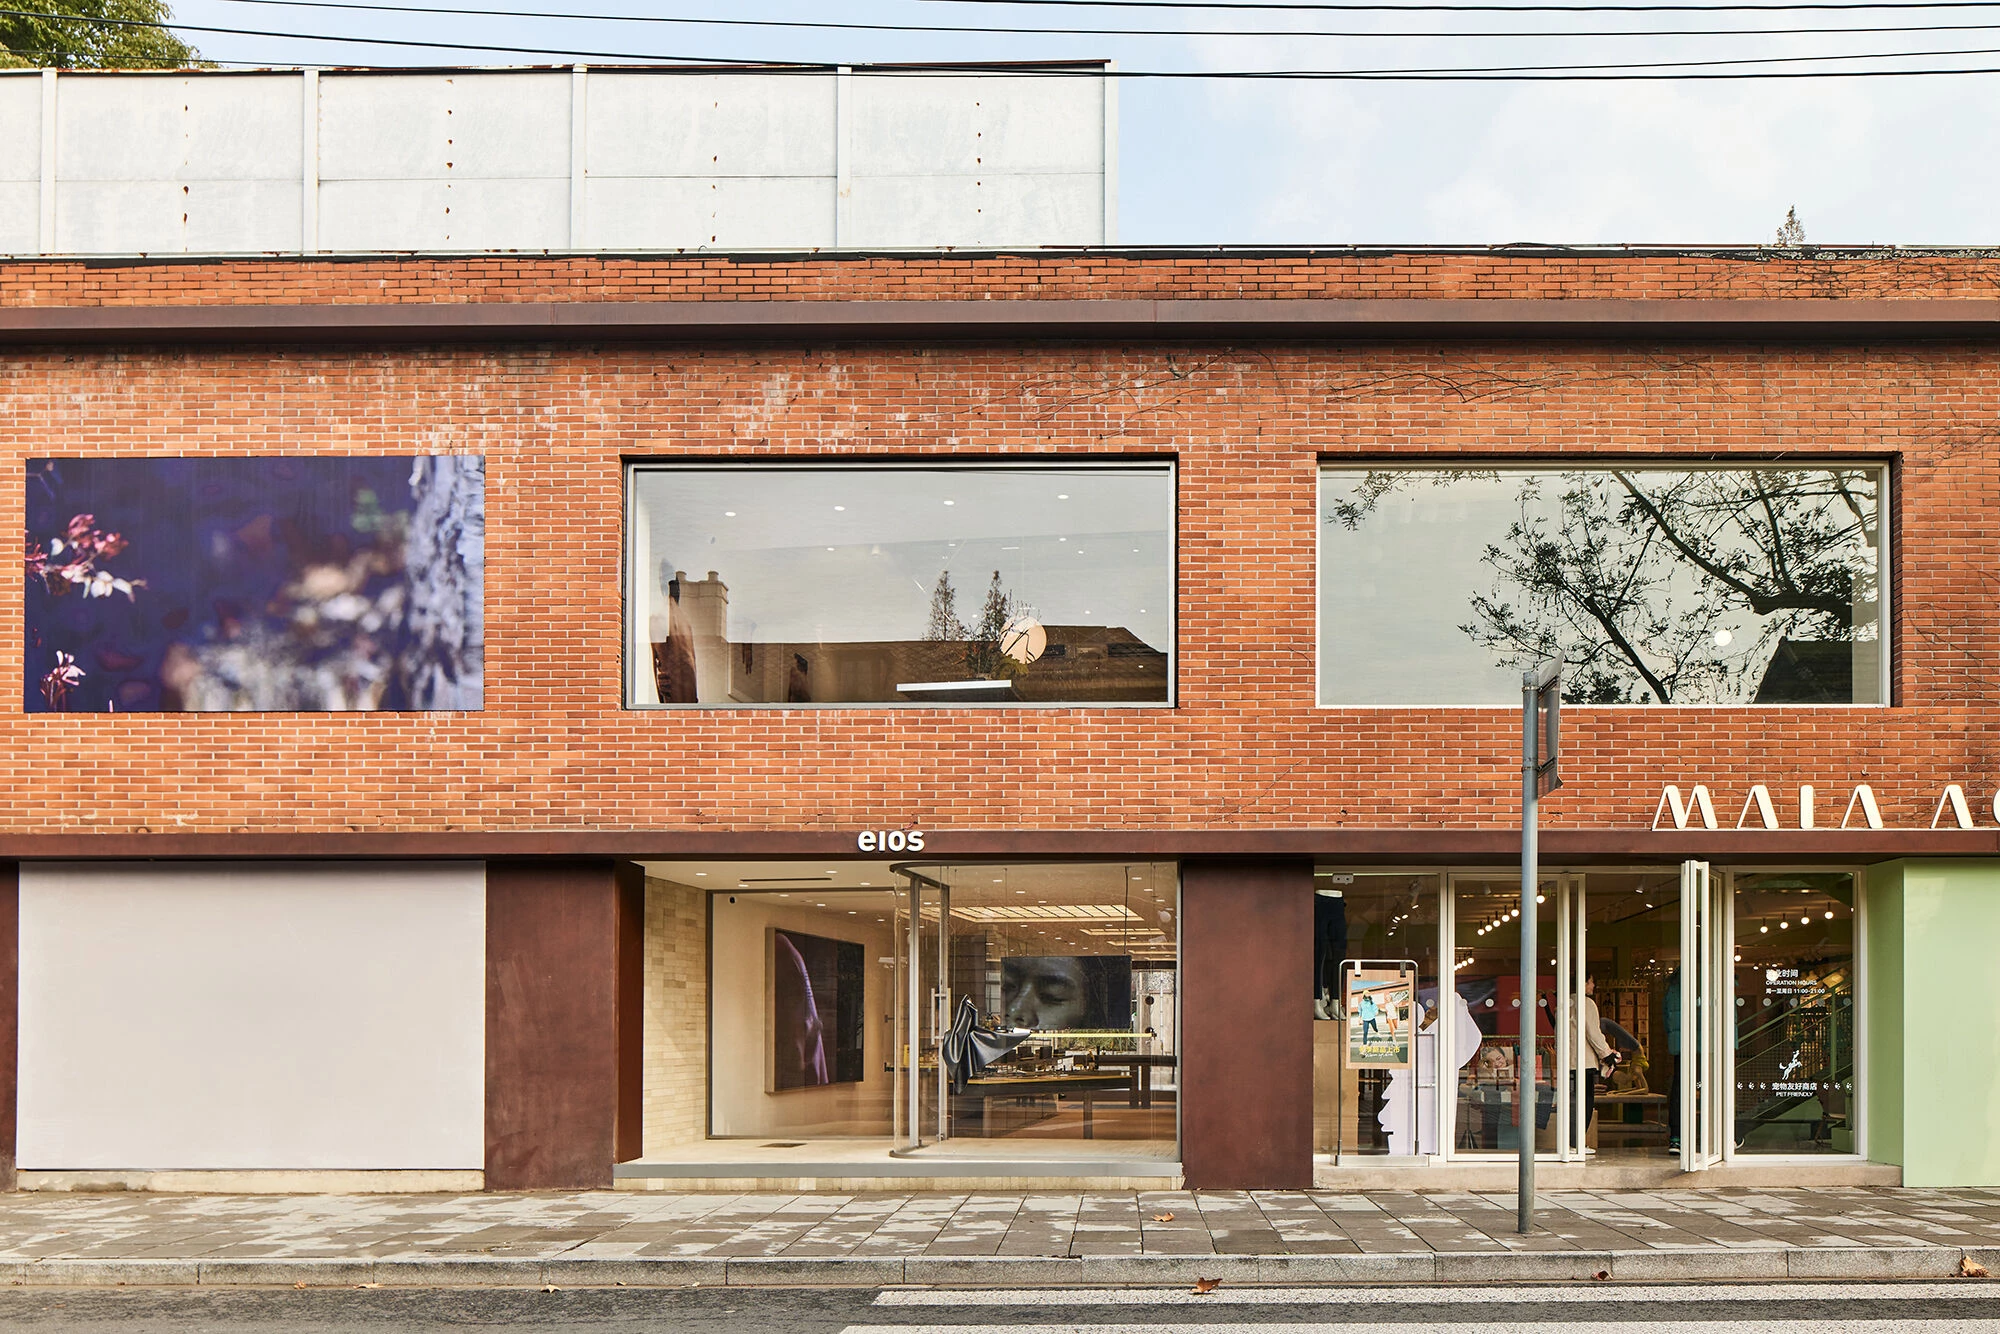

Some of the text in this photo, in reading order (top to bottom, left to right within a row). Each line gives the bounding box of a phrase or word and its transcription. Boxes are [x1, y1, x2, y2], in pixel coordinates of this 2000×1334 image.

[1651, 784, 2000, 829] MAIA A
[1771, 1082, 1818, 1091] 宠物友好商店
